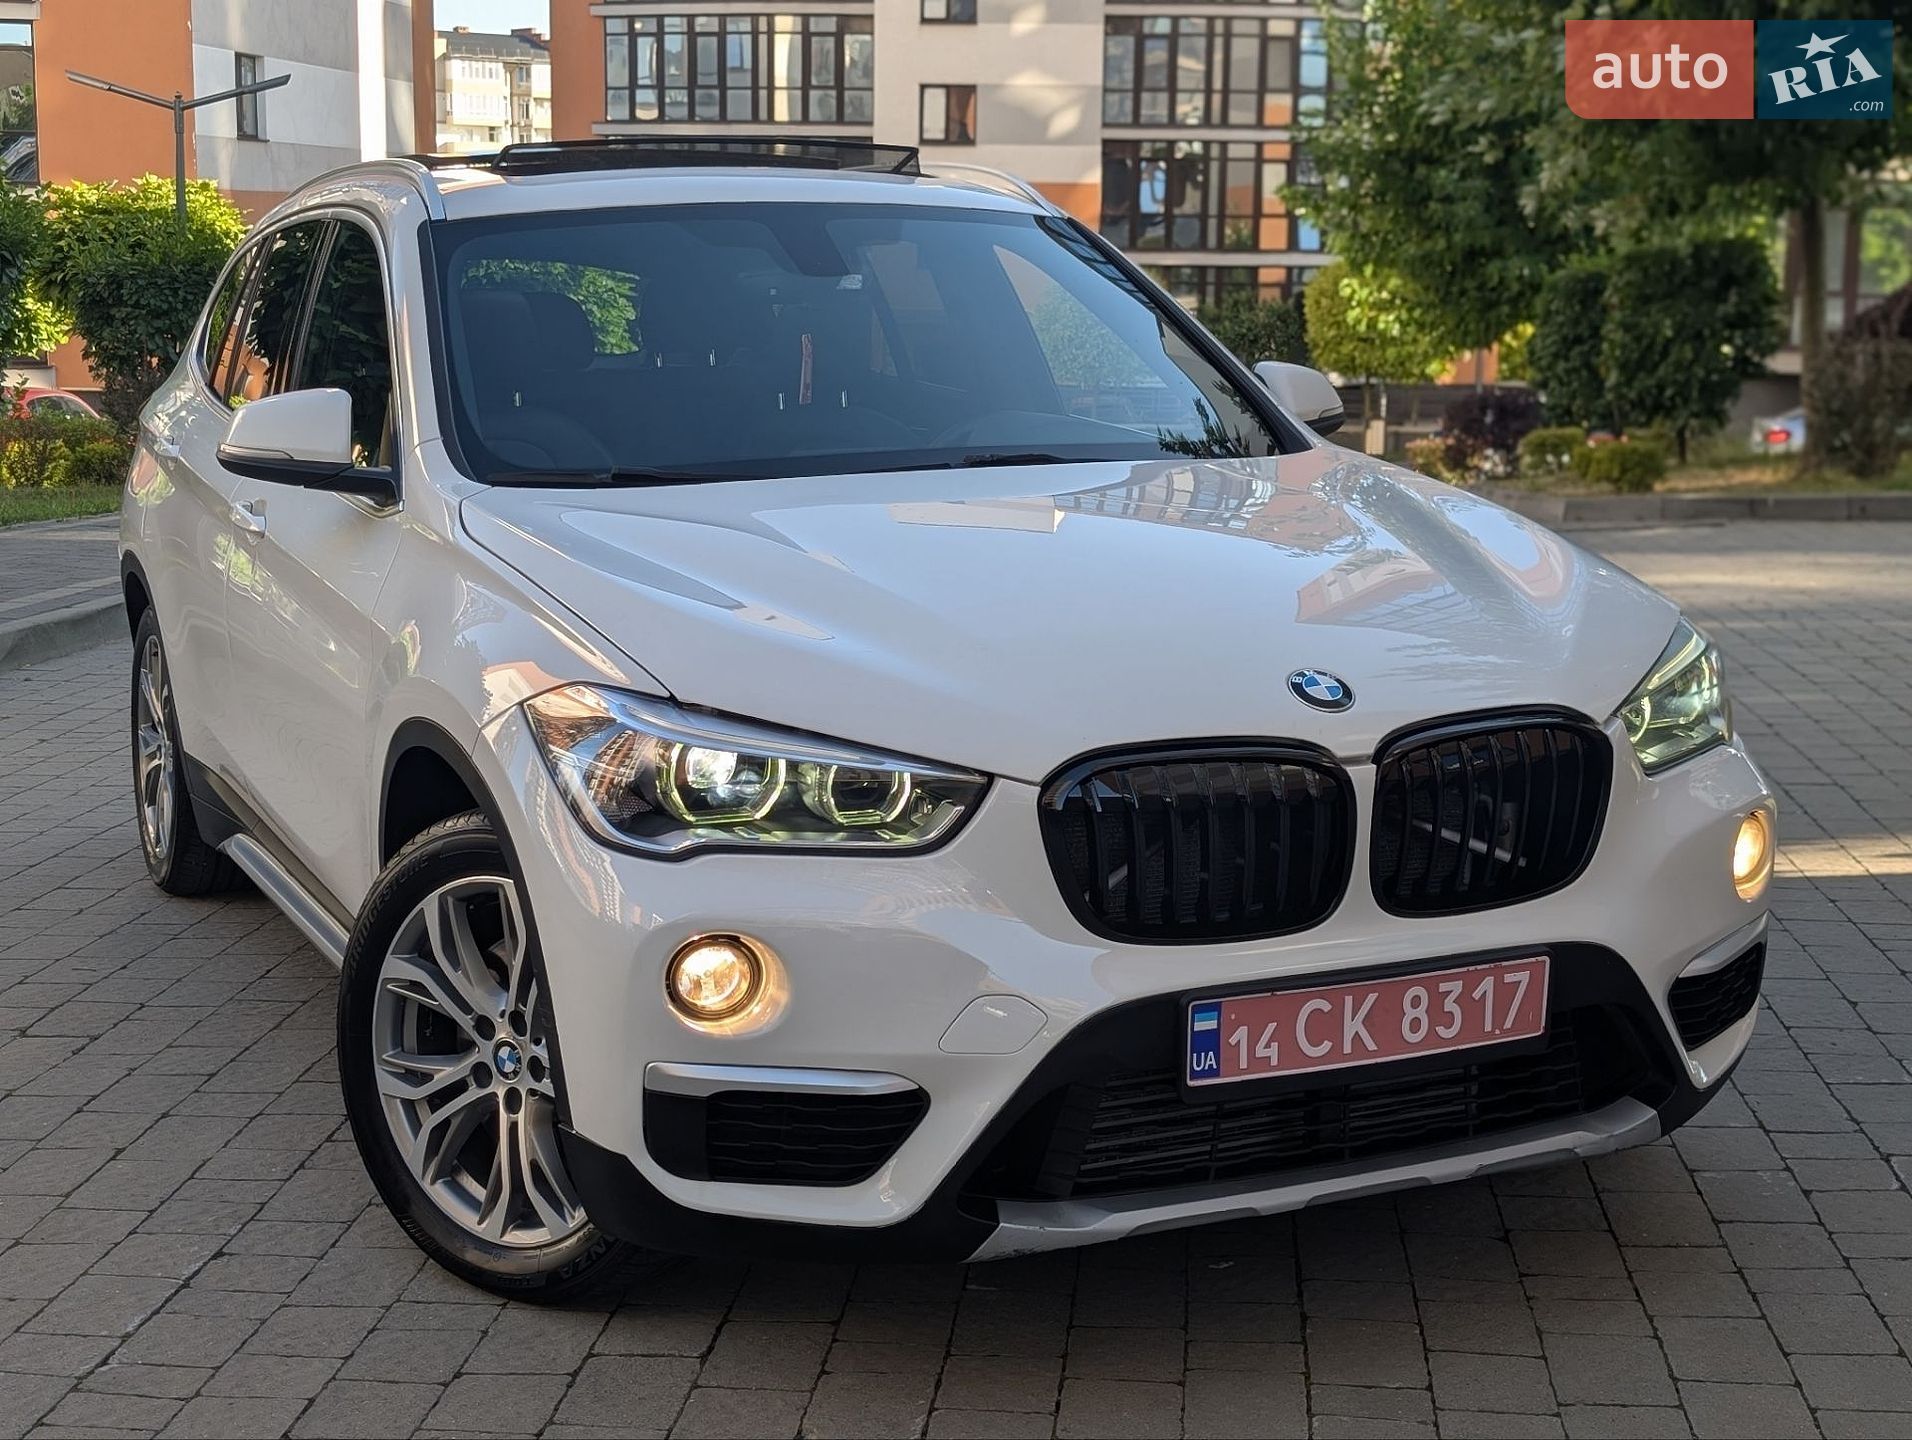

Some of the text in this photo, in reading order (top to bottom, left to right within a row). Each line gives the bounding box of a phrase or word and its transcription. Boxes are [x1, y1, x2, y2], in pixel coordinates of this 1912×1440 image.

[1228, 971, 1531, 1069] 14 CK 8317
[1193, 1051, 1218, 1071] UA
